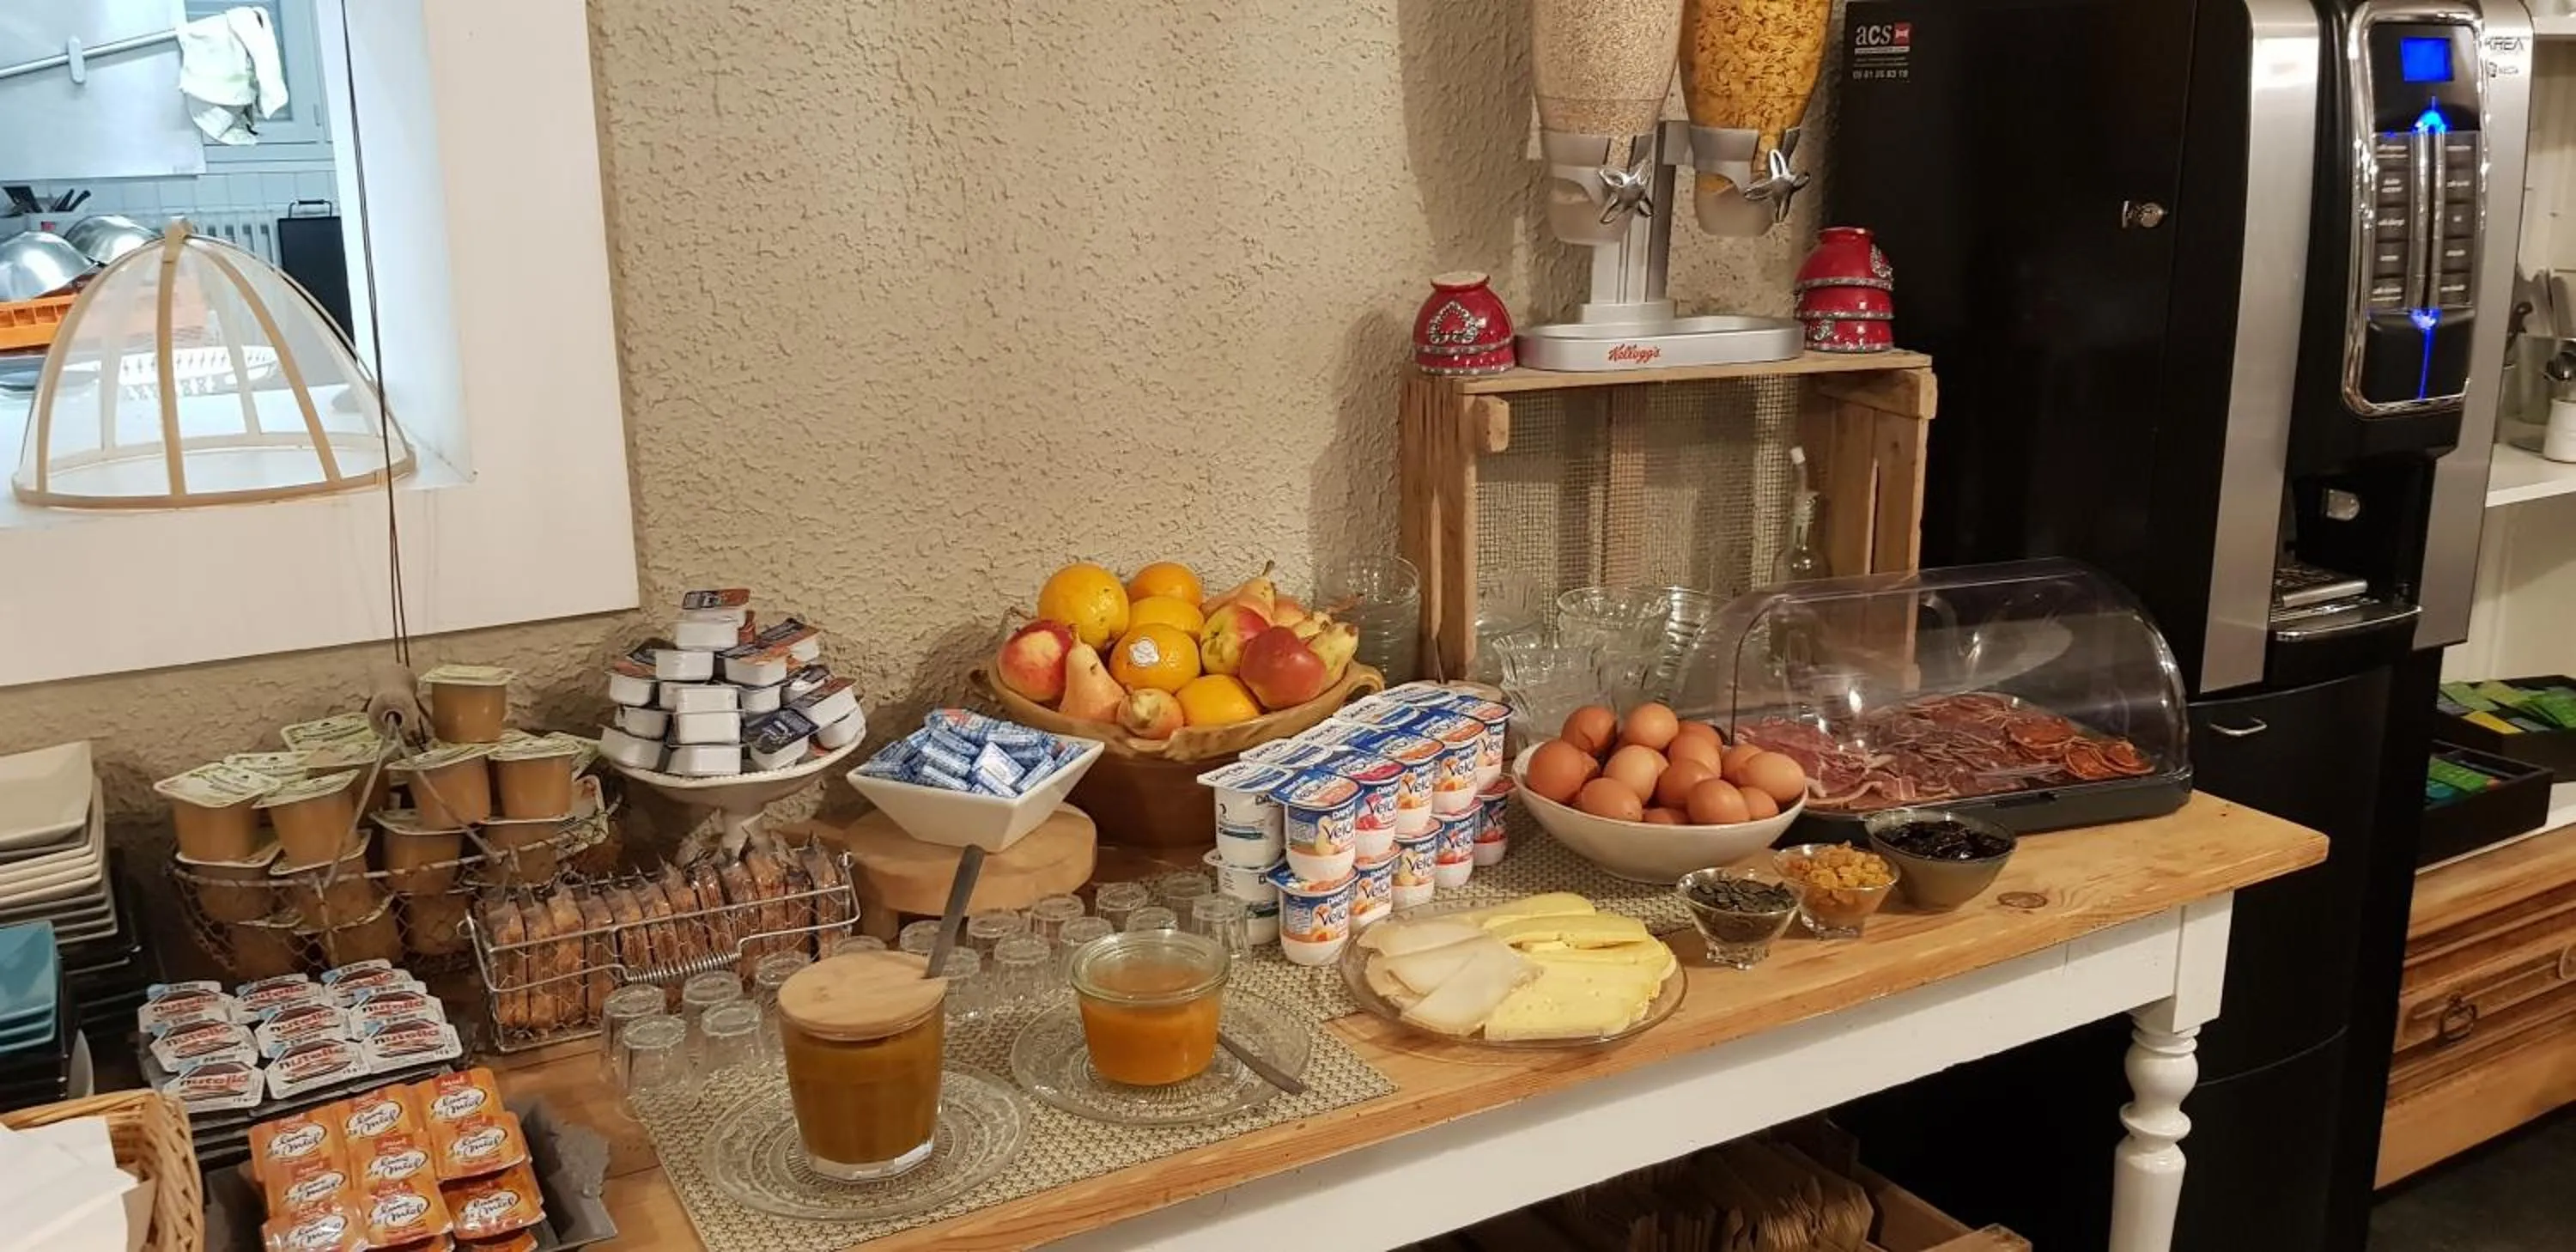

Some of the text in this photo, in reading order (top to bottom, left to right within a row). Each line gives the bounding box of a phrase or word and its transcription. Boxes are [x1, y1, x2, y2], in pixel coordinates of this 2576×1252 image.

[1856, 25, 1893, 46] acs
[1608, 343, 1661, 363] Kellogg's
[362, 999, 425, 1013] nutella
[166, 1024, 229, 1047] nutella
[374, 1030, 440, 1045] nutella
[278, 1045, 344, 1069] nutella
[180, 1073, 248, 1086] nutella
